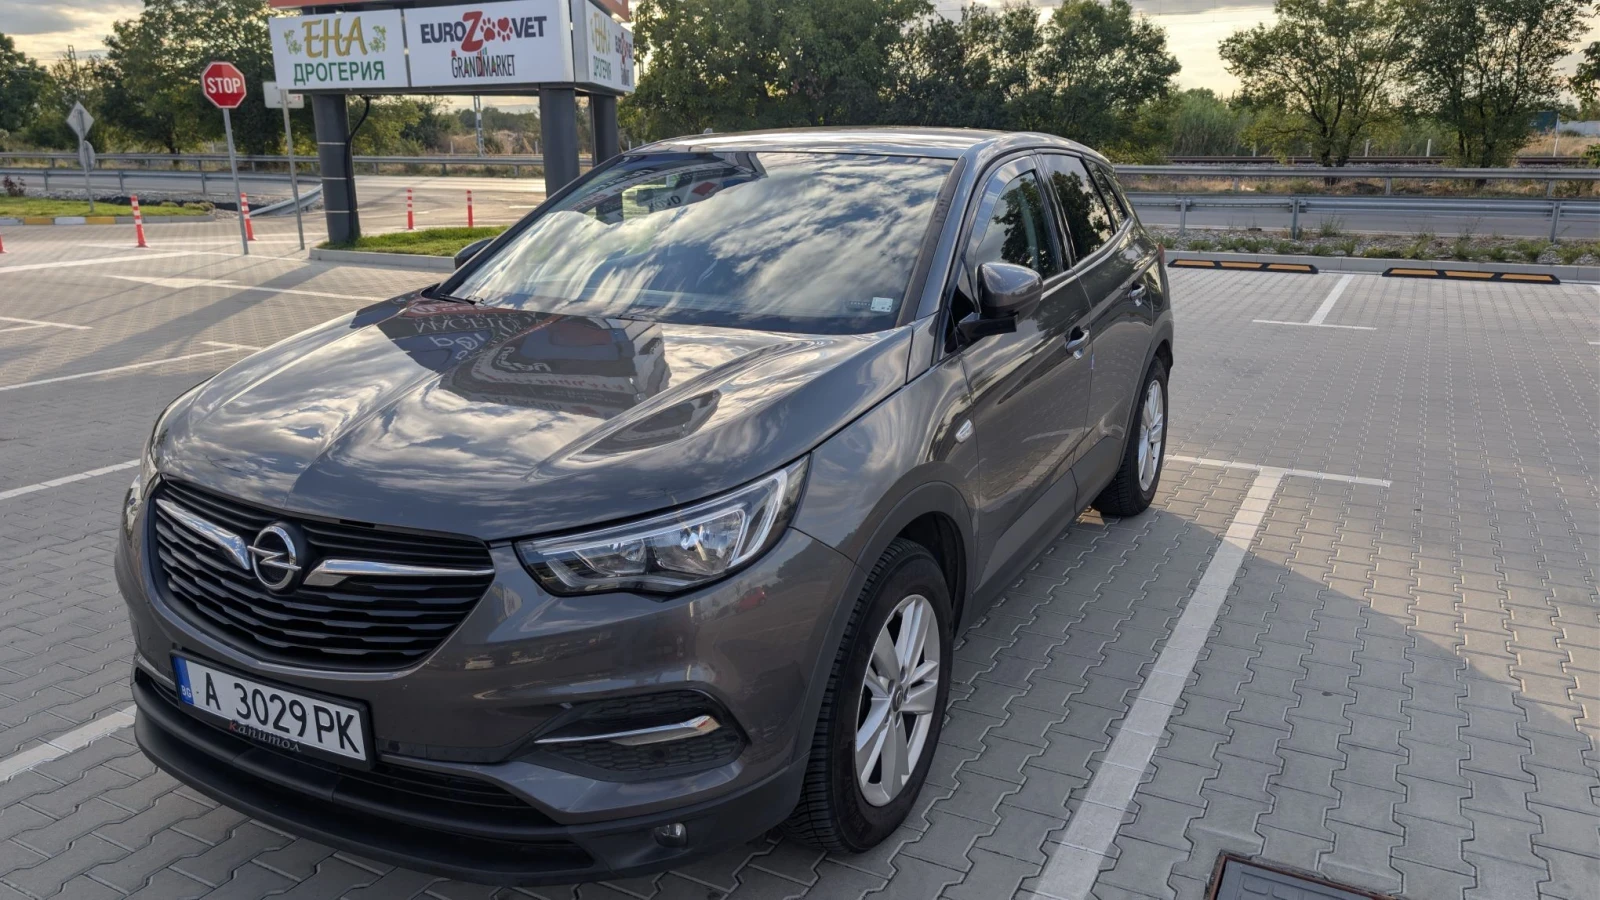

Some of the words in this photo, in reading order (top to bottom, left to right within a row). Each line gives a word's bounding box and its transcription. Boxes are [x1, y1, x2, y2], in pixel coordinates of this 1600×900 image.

[294, 61, 385, 86] ДРОГЕРИЯ
[207, 77, 241, 94] STOP
[181, 685, 192, 698] BG
[205, 672, 221, 711] A
[233, 682, 307, 738] 3029
